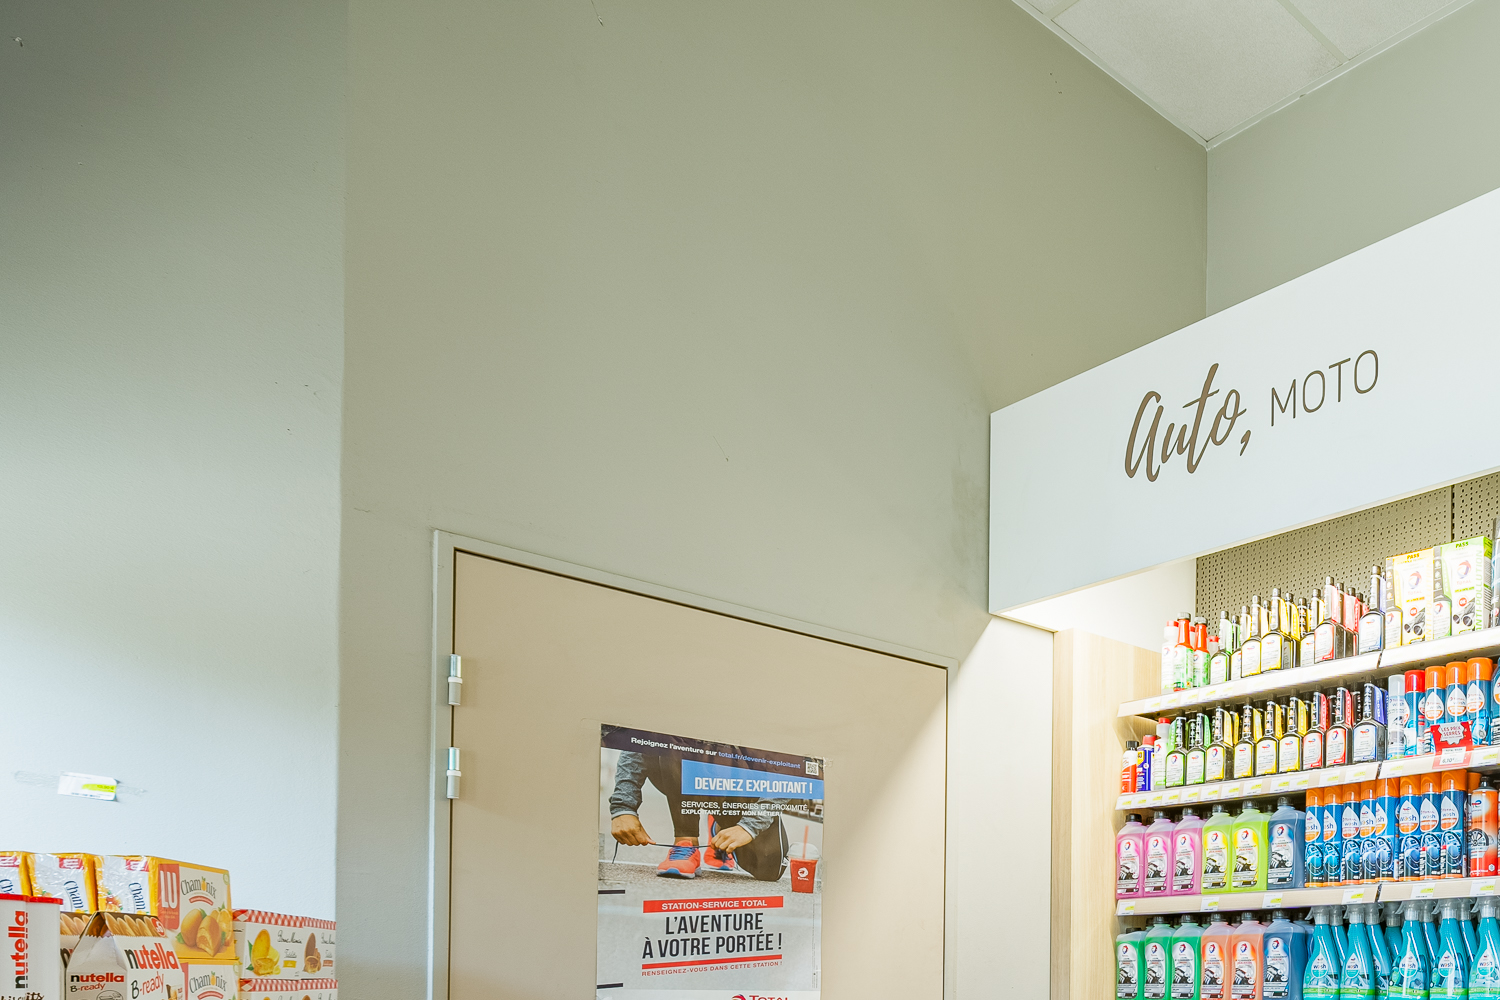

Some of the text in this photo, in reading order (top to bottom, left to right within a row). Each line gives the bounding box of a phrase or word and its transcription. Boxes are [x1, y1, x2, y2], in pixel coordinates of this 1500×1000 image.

[1124, 349, 1379, 483] Auto, MOTO
[631, 737, 668, 749] Rejoignez
[670, 744, 701, 754] l'aventure
[718, 750, 800, 769] total.fr/devenir-exploitant
[695, 777, 813, 793] DEVENEZ EXPLOITANT !
[681, 801, 720, 809] SERVICES,
[722, 800, 758, 810] ÉNERGIES
[159, 870, 178, 909] LU
[662, 899, 767, 910] STATION-SERVICE TOTAL
[665, 912, 763, 935] L'AVENTURE
[8, 910, 29, 989] nutella
[127, 943, 179, 970] nutella
[642, 931, 782, 958] À VOTRE PORTÉE !
[70, 973, 124, 983] nutella
[642, 966, 708, 976] RENSEIGNEZ-VOUS
[70, 983, 105, 993] B-ready
[131, 972, 164, 999] B-ready
